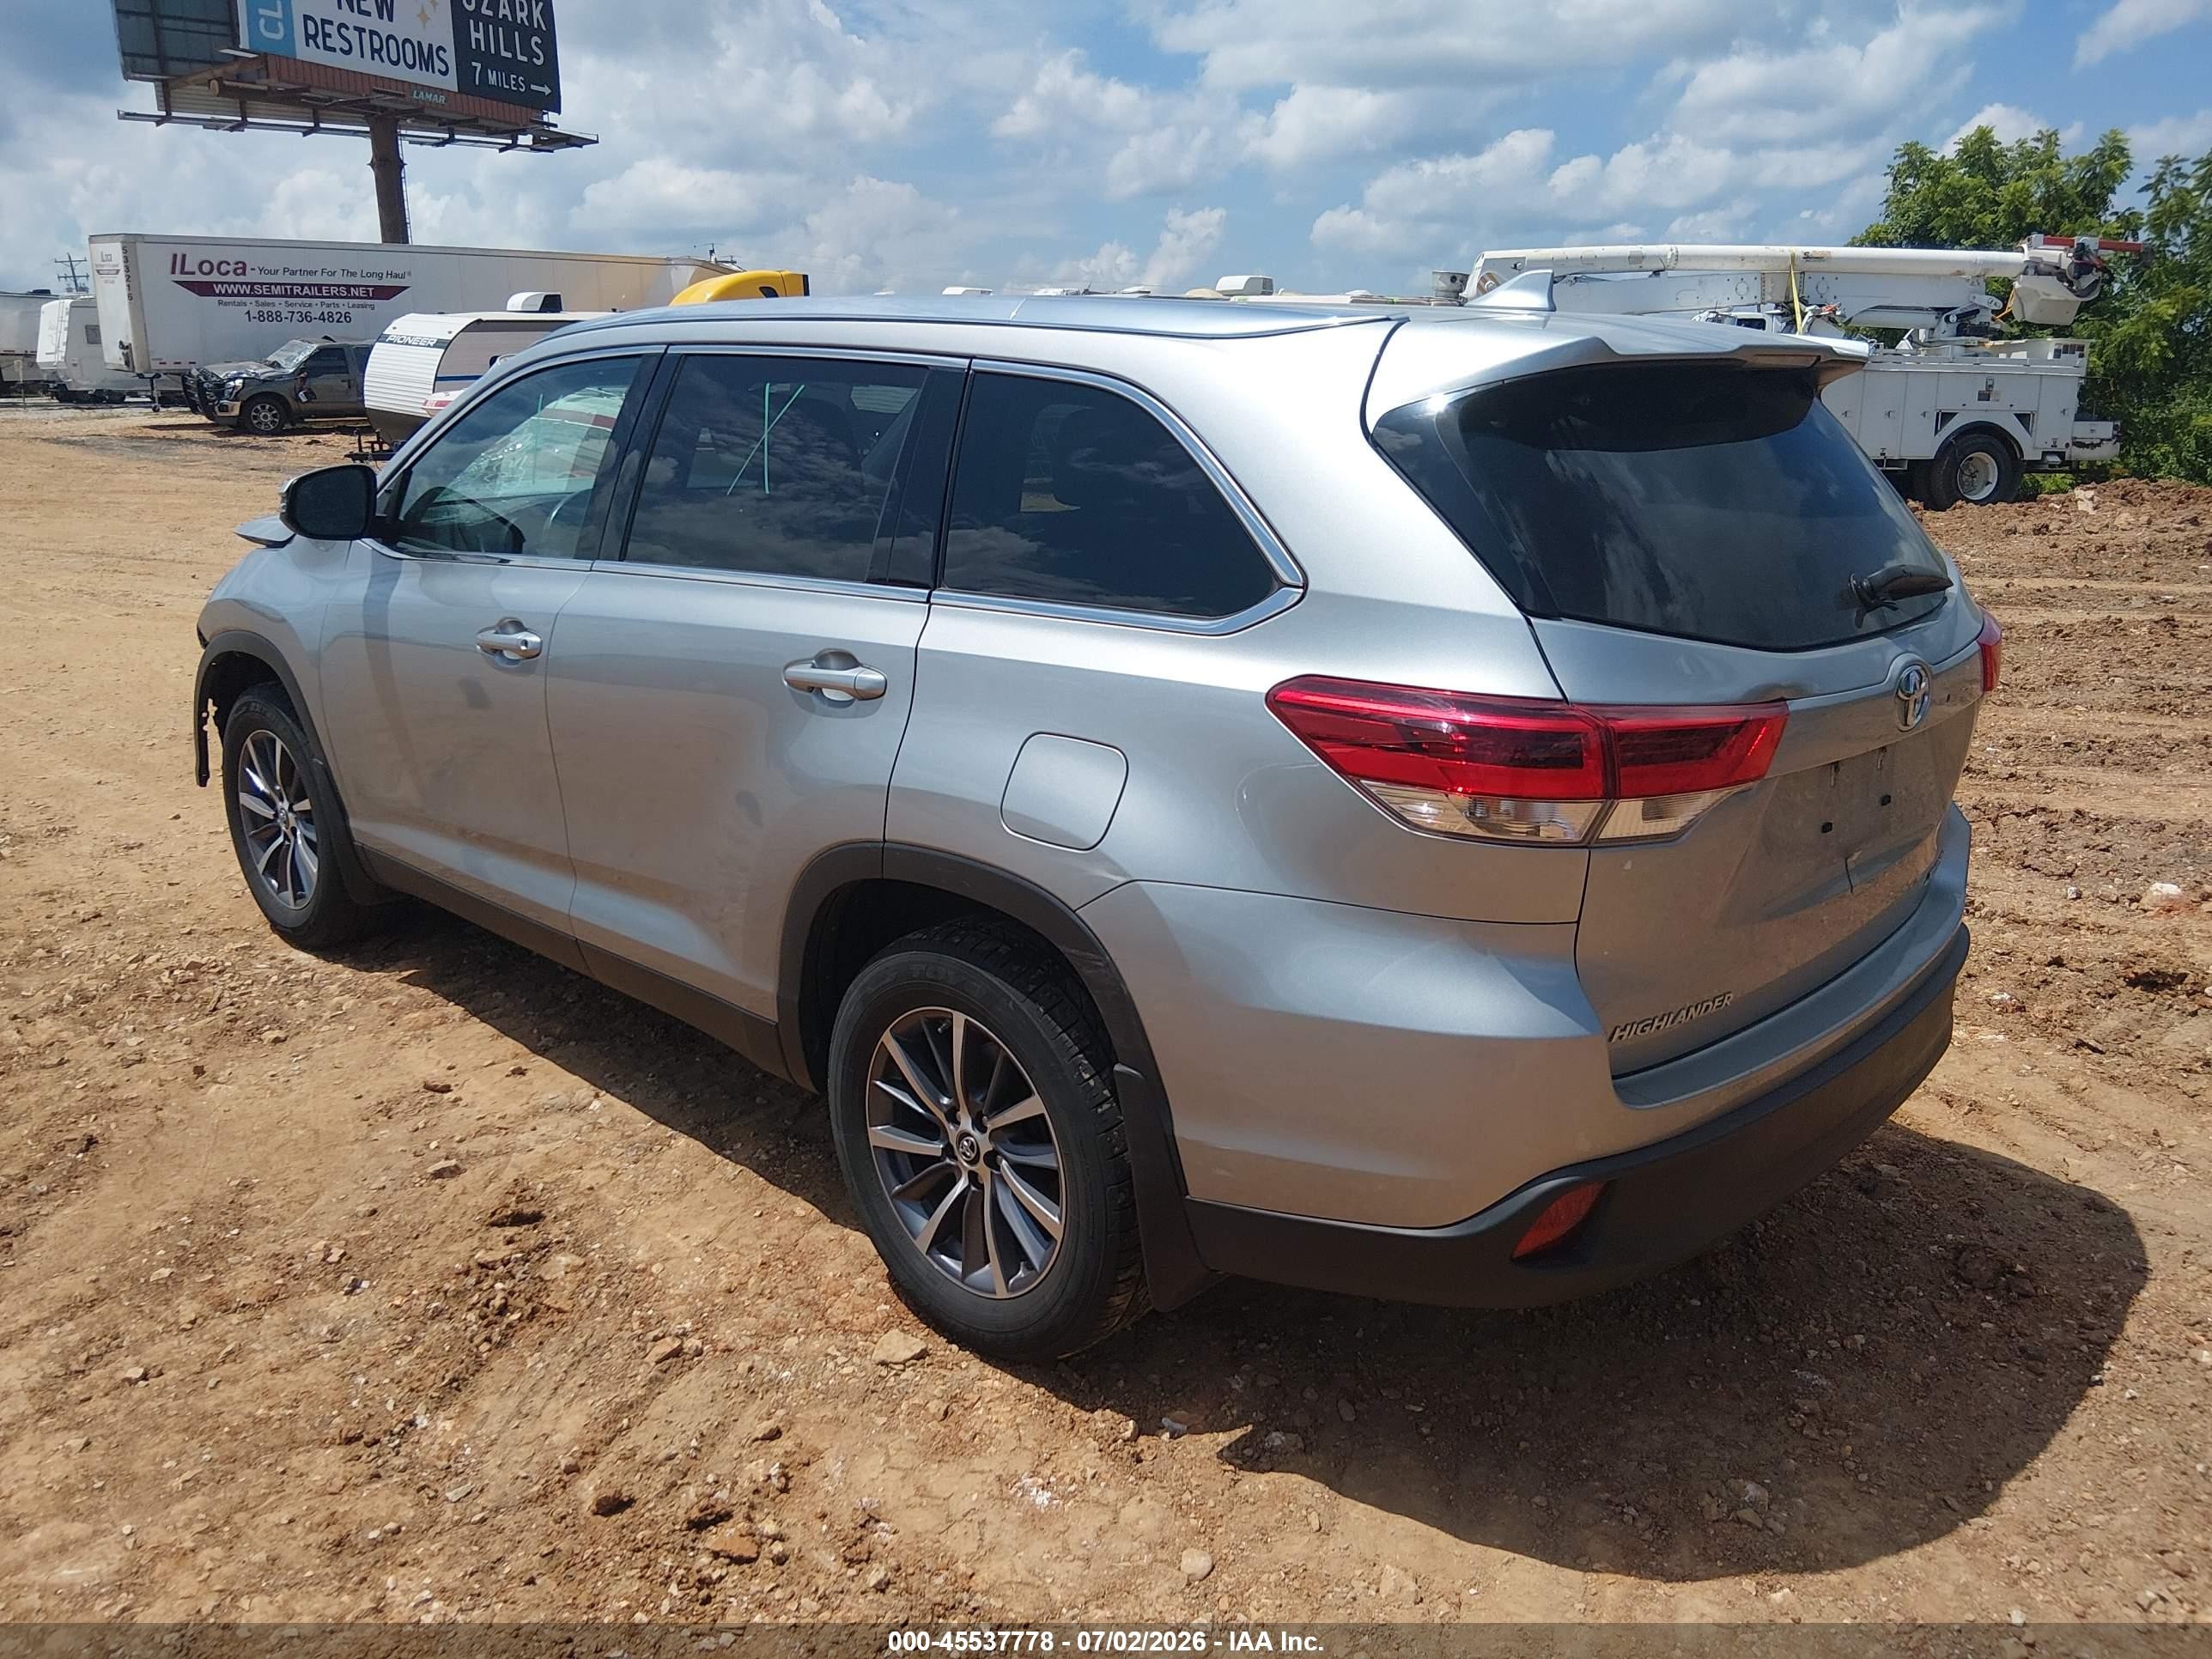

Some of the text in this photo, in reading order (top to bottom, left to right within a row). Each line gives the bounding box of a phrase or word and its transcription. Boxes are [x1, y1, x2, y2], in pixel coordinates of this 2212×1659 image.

[303, 14, 450, 76] RESTROOMS
[469, 19, 544, 65] HILLS
[471, 62, 526, 92] 7 MILES
[413, 90, 446, 103] LAMAR
[170, 252, 247, 276] ILoca
[258, 265, 280, 276] Your
[283, 267, 319, 276] Partner
[320, 268, 337, 277] For
[341, 269, 358, 278] The
[360, 270, 384, 281] Long
[386, 270, 406, 279] Haul
[213, 283, 374, 297] WWW.SEMITRAILERS.NET
[244, 309, 352, 323] 1-888-736-4826
[385, 335, 438, 347] PIONEER
[1607, 991, 1734, 1043] HIGHLANDER
